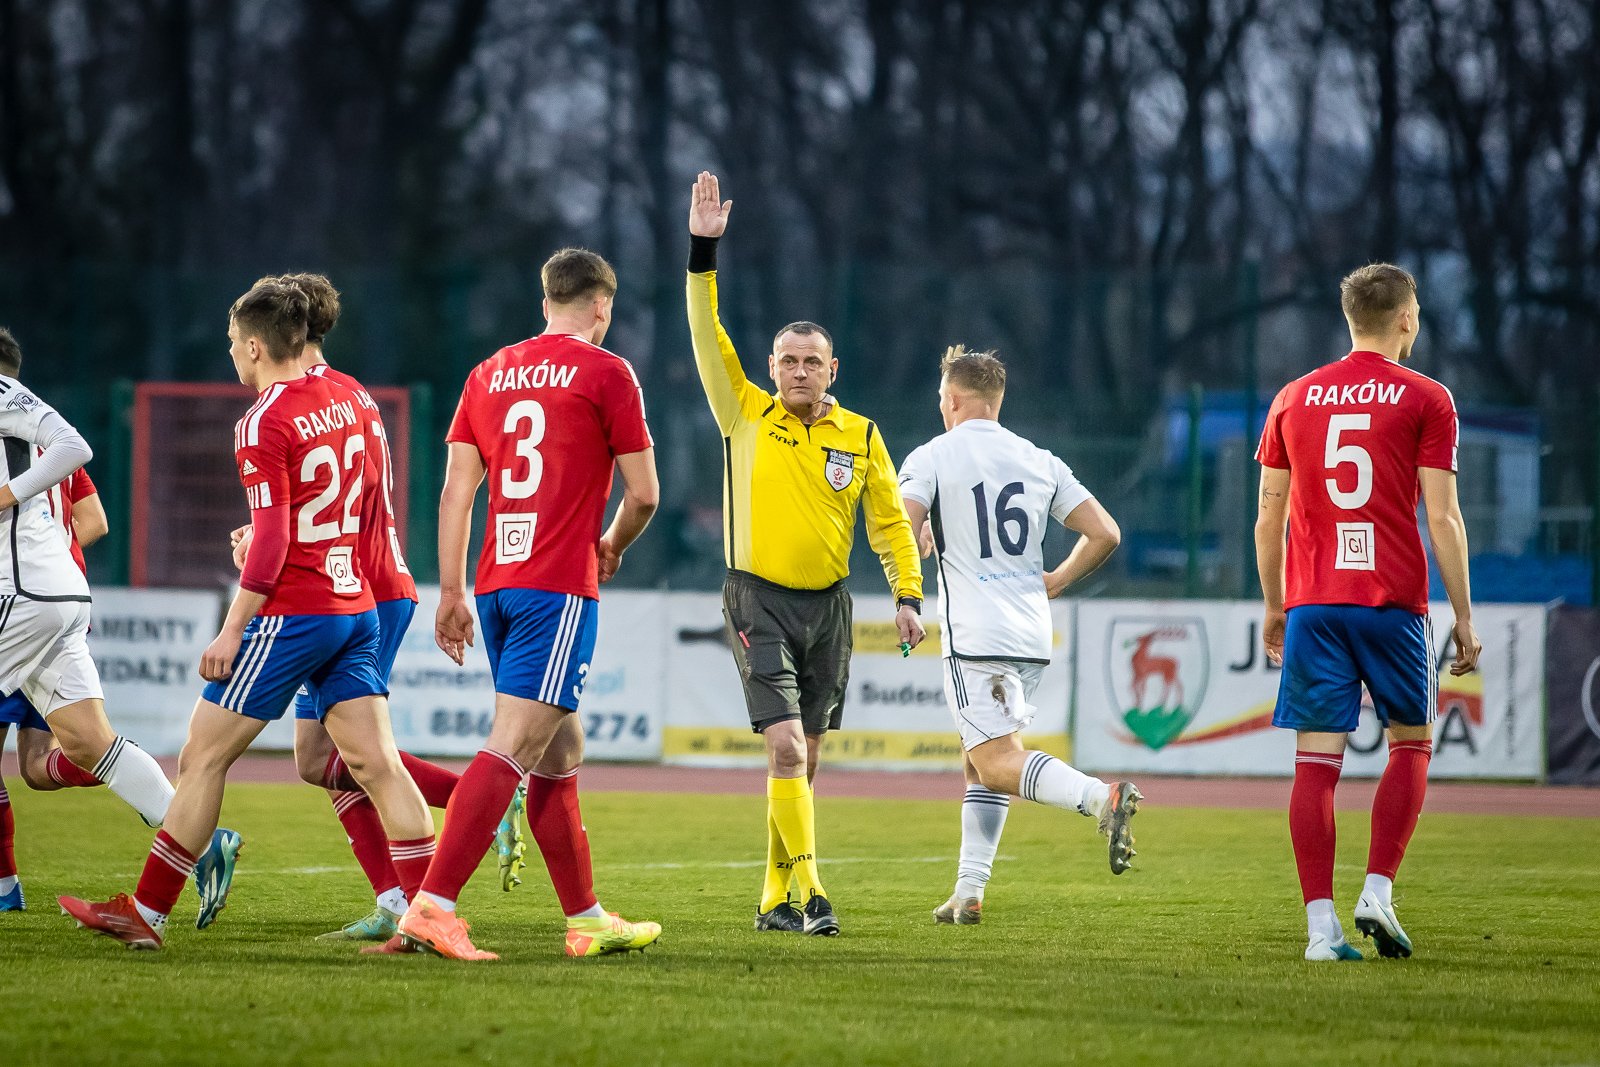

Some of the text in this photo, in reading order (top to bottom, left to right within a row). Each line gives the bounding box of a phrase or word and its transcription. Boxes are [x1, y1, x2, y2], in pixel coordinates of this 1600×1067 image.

[488, 358, 579, 394] RAKÓW
[1305, 378, 1406, 407] RAKÓW
[293, 398, 357, 441] RAKÓW
[501, 399, 546, 499] 3
[297, 433, 366, 543] 22
[1324, 413, 1374, 510] 5
[971, 481, 1030, 559] 16
[573, 662, 590, 701] 3
